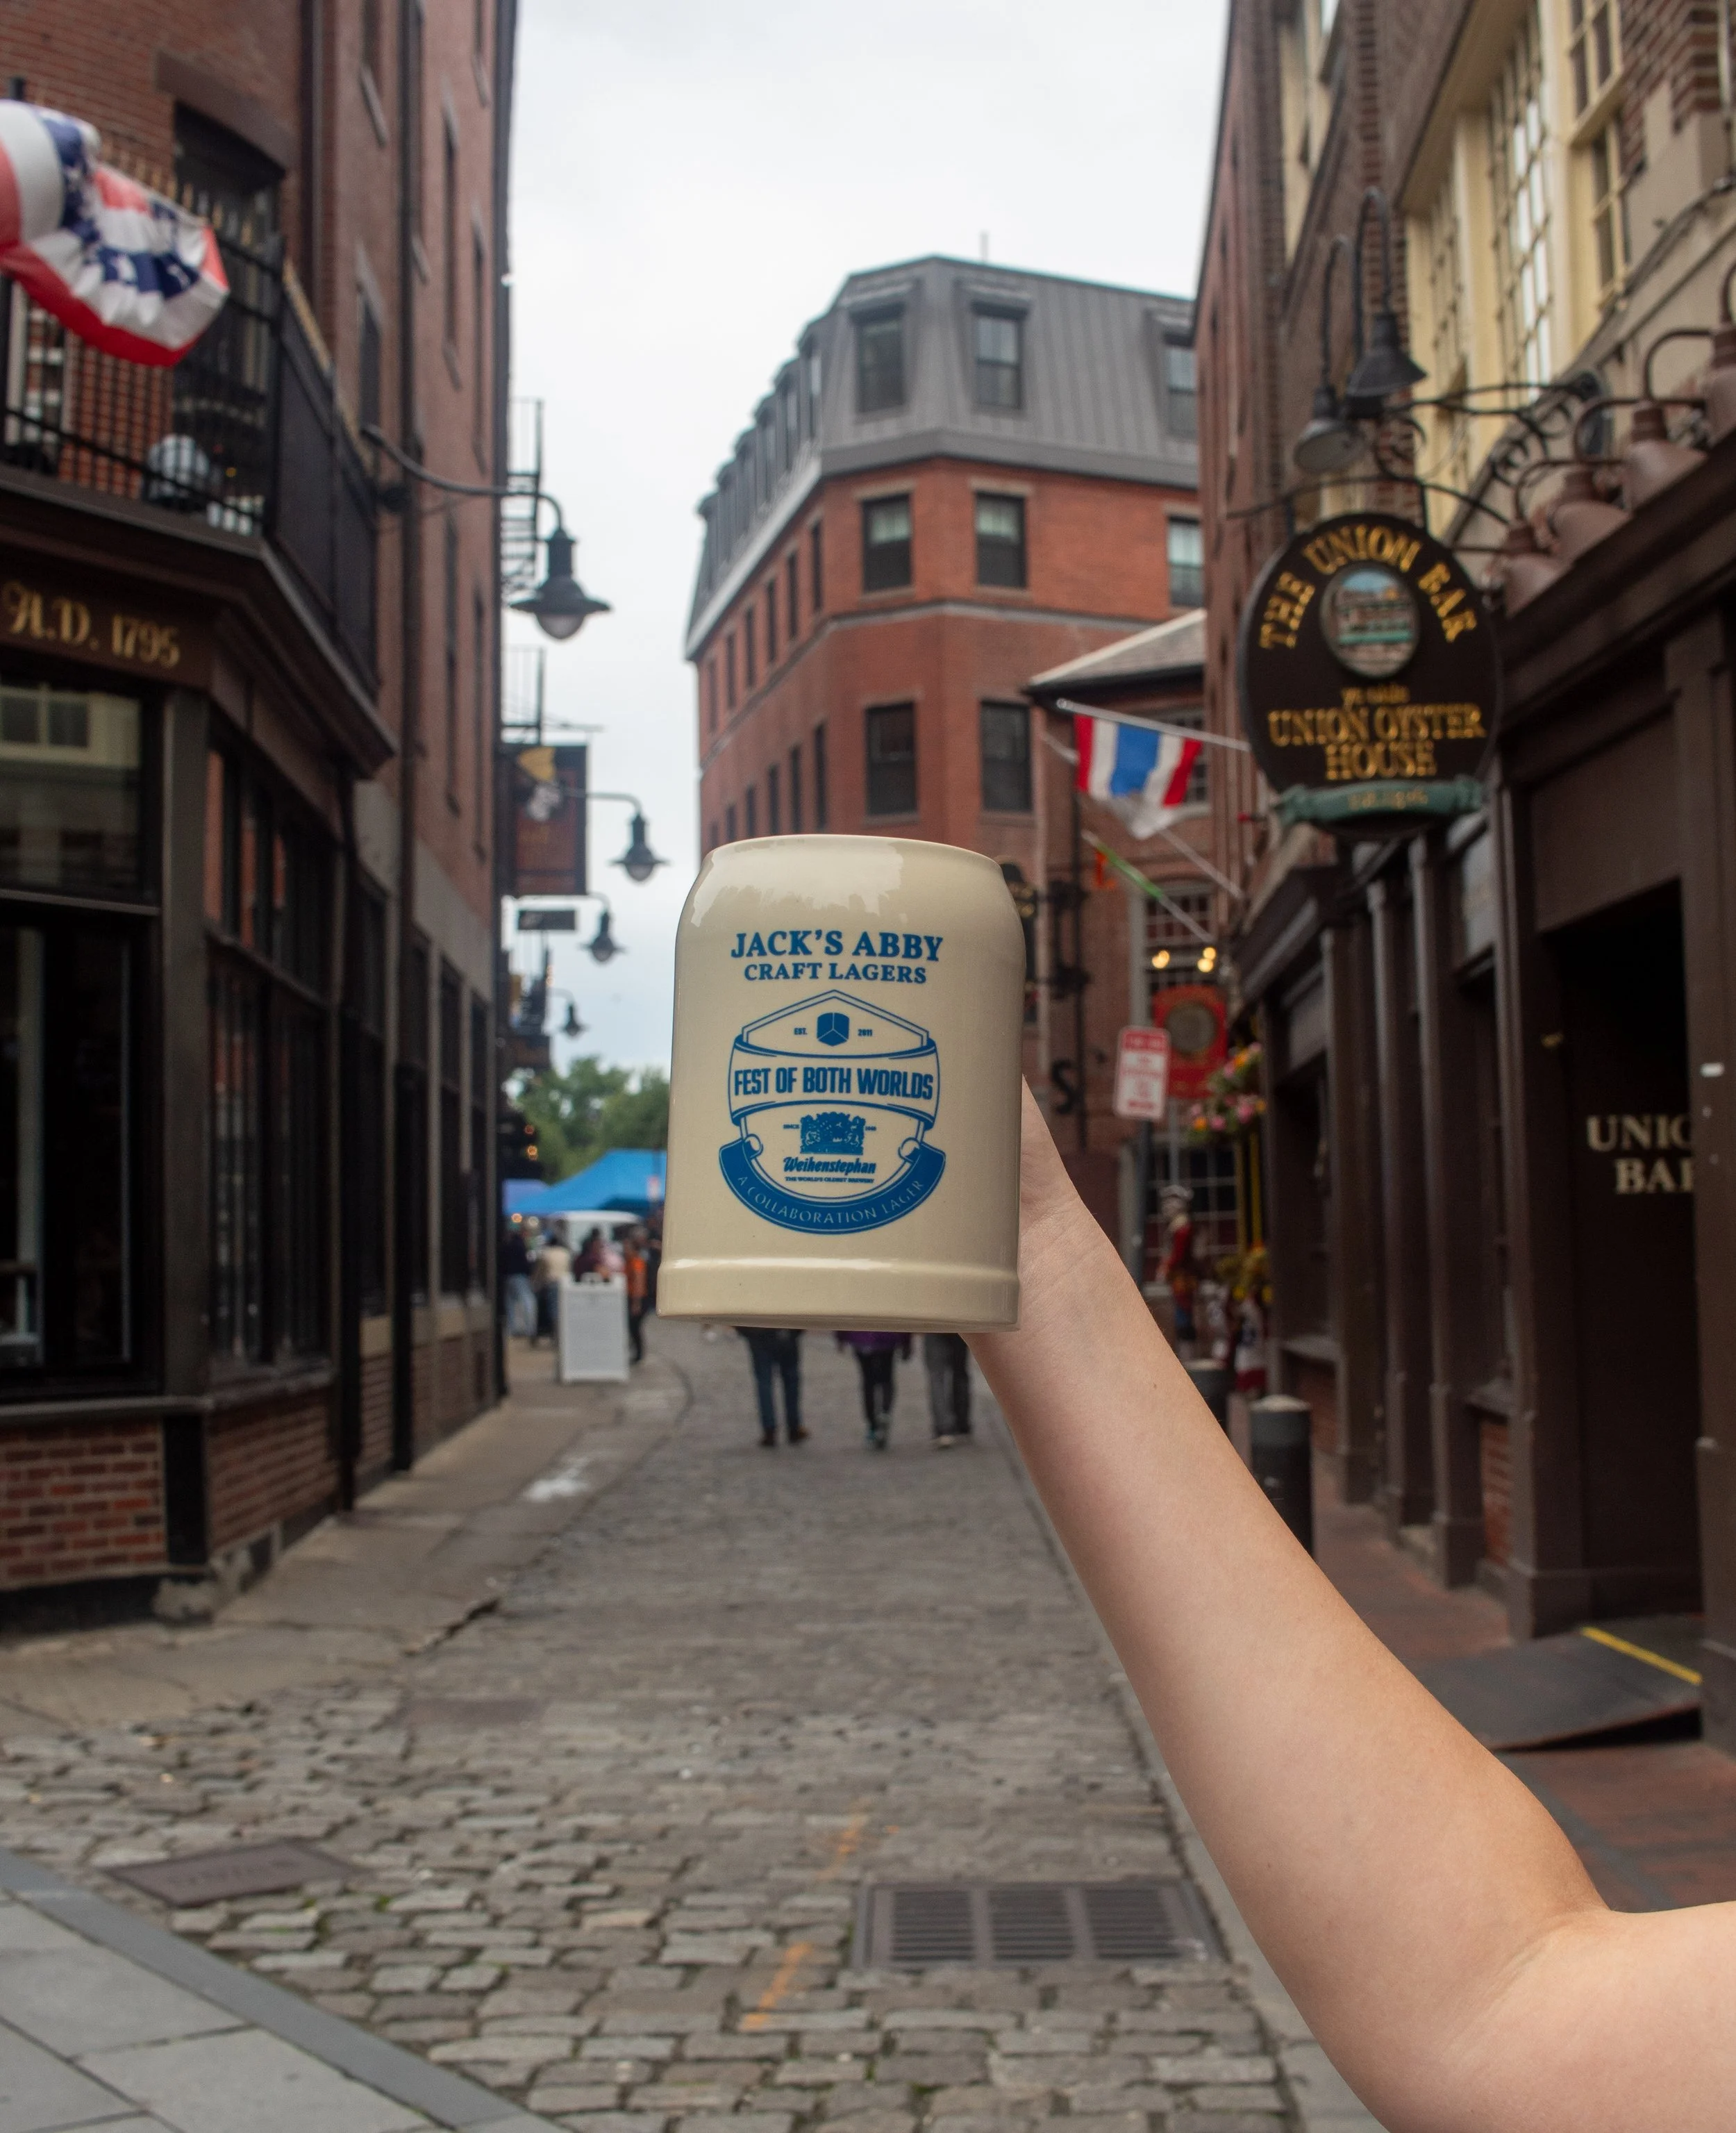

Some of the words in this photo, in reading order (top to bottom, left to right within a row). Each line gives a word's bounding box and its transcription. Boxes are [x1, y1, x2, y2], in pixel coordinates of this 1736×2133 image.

[1259, 571, 1316, 649] THE
[1303, 524, 1424, 575] UNION
[1418, 561, 1477, 643] BAR
[1, 579, 99, 651] A.D.
[111, 614, 180, 667] 1795
[1267, 706, 1369, 747] UNION
[1374, 702, 1488, 739] OYSTER
[1325, 739, 1437, 781] HOUSE
[731, 929, 843, 958] JACK'S
[852, 931, 944, 962] ABBY
[744, 963, 822, 981] CRAFT
[828, 964, 927, 984] LAGERS
[794, 1027, 808, 1036] EST.
[734, 1068, 771, 1096] FEST
[775, 1068, 797, 1093] OF
[803, 1068, 851, 1094] BOTH
[857, 1068, 934, 1100] WORLDS
[1586, 1115, 1692, 1152] UNIO
[783, 1156, 876, 1176] Weihenstephan
[737, 1175, 748, 1186] A
[747, 1188, 877, 1224] COLLABORATION
[883, 1180, 924, 1213] LAGER
